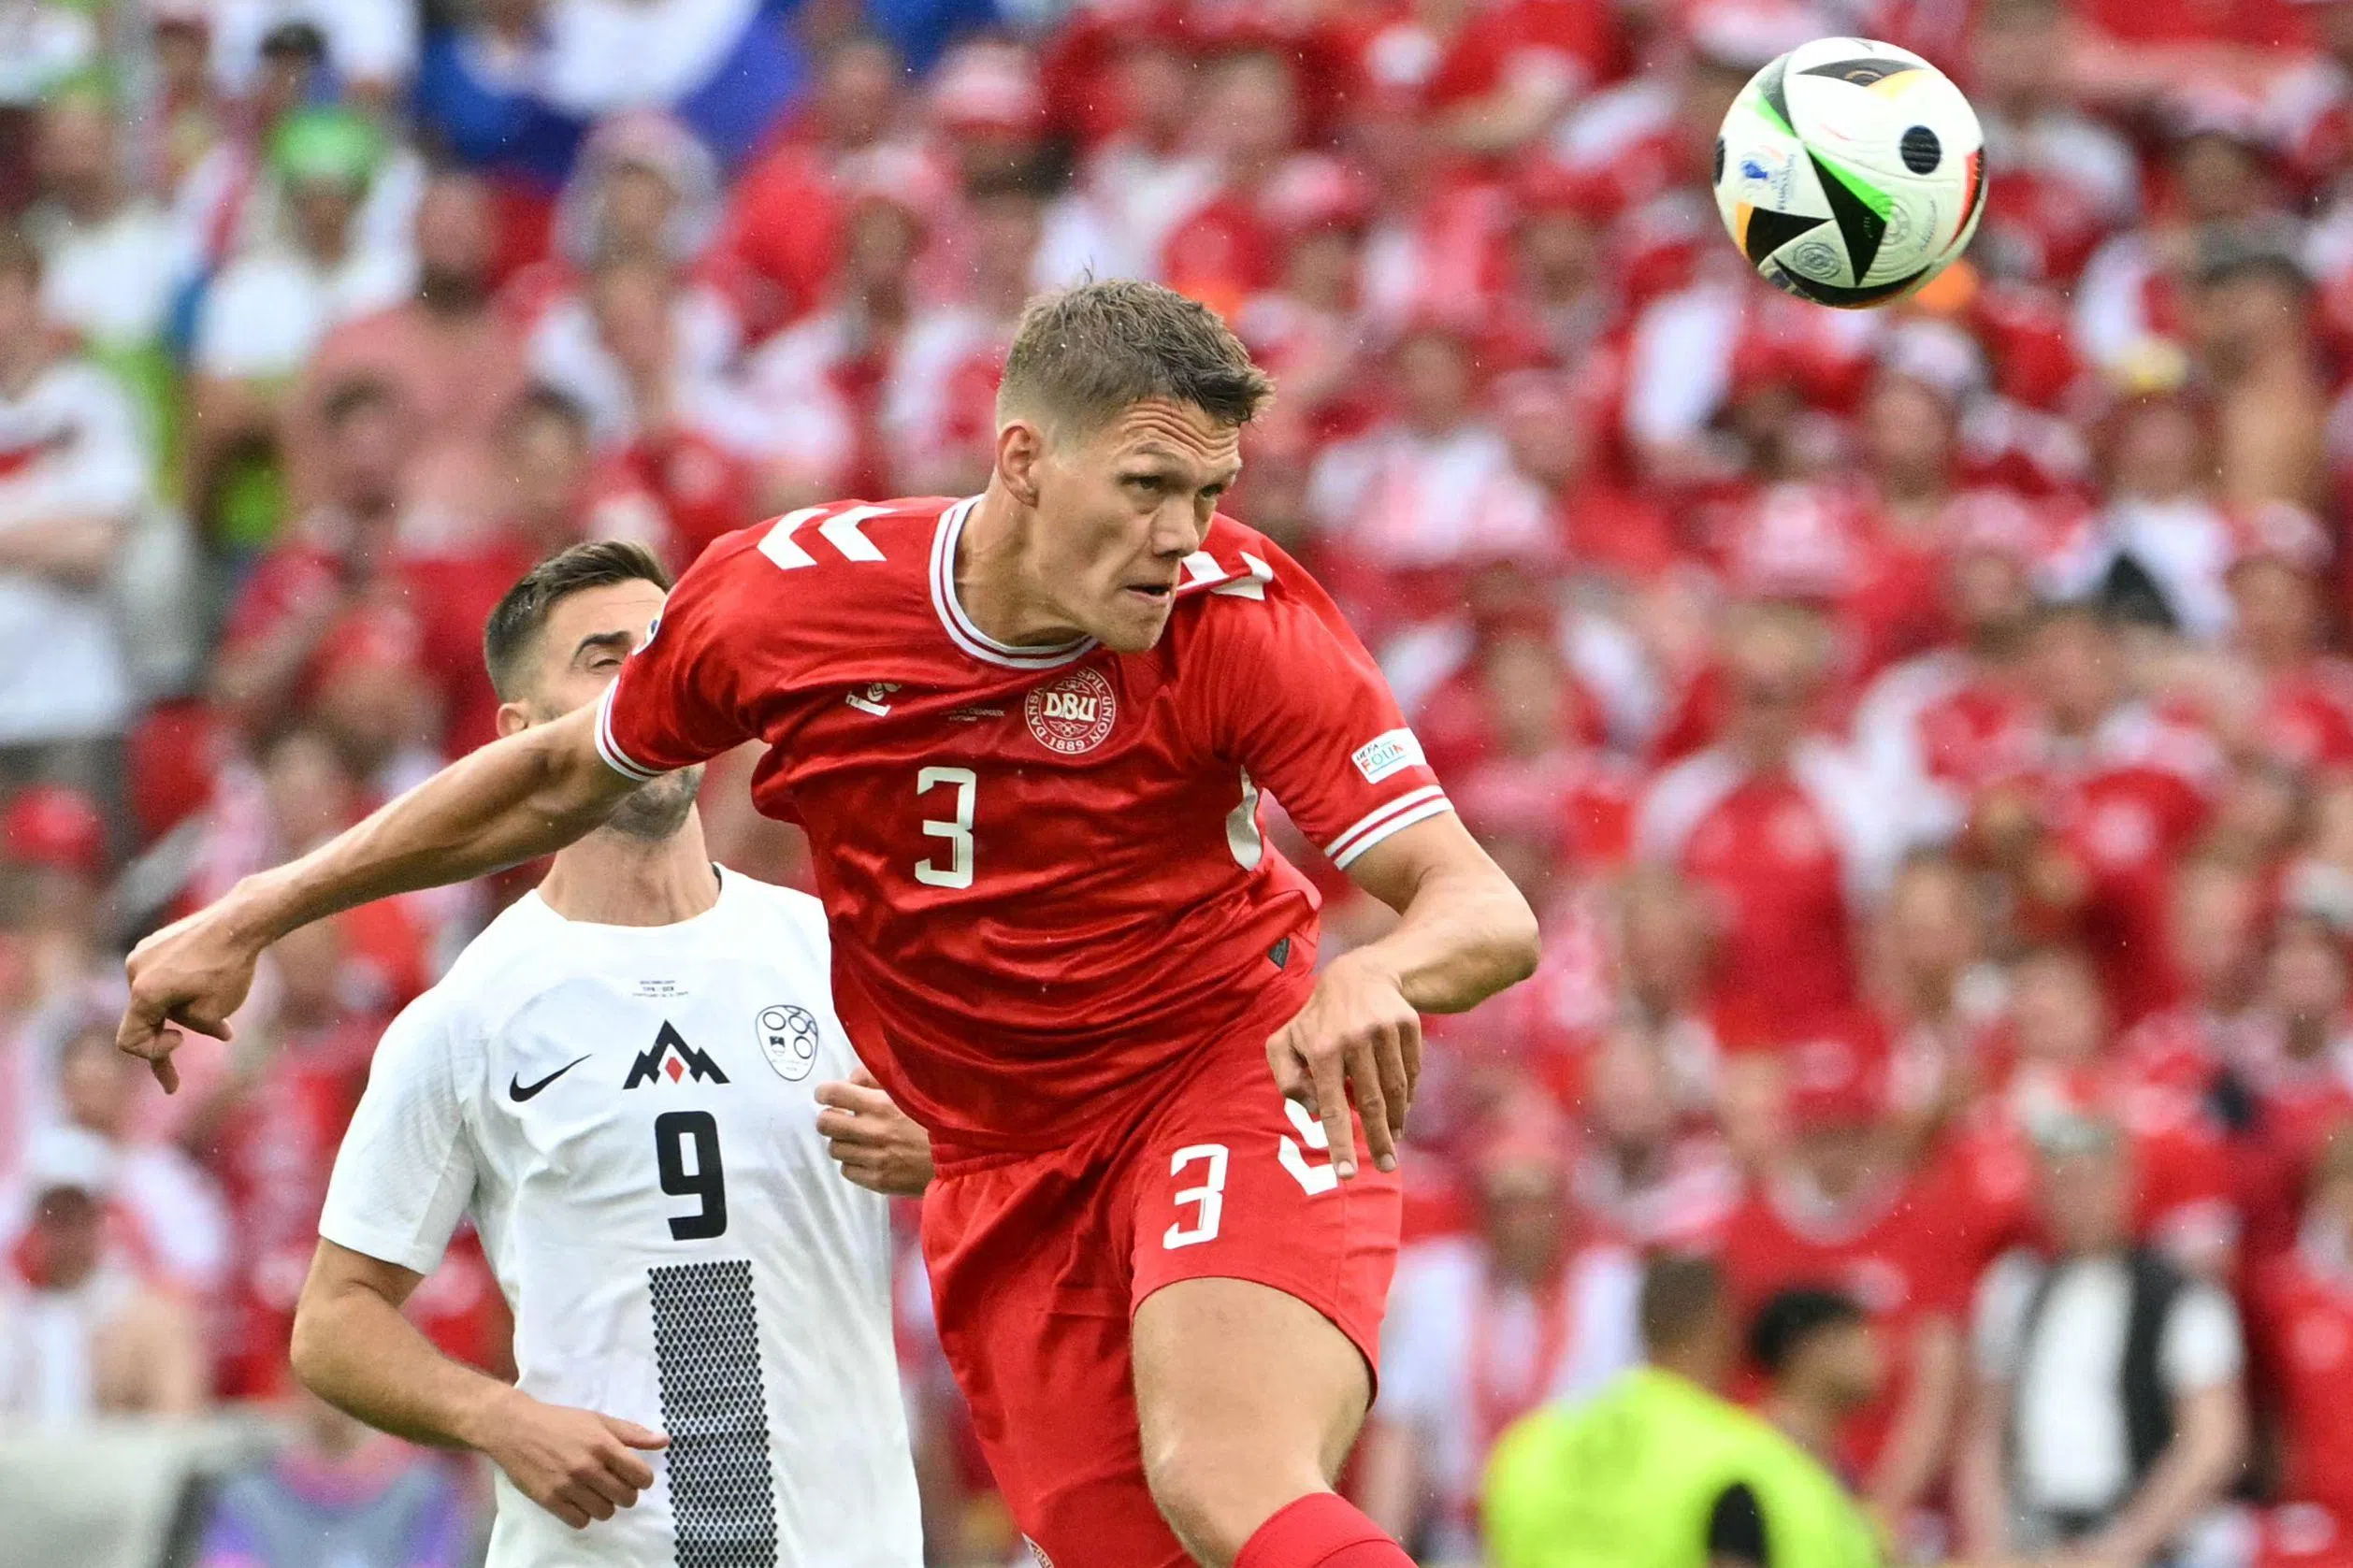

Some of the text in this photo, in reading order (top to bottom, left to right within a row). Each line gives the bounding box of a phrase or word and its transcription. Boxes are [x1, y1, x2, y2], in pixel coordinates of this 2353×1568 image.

[1043, 692, 1097, 722] DBU
[1048, 736, 1085, 751] 1889
[915, 766, 977, 889] 3
[655, 1110, 728, 1241] 9
[1162, 1143, 1230, 1250] 3
